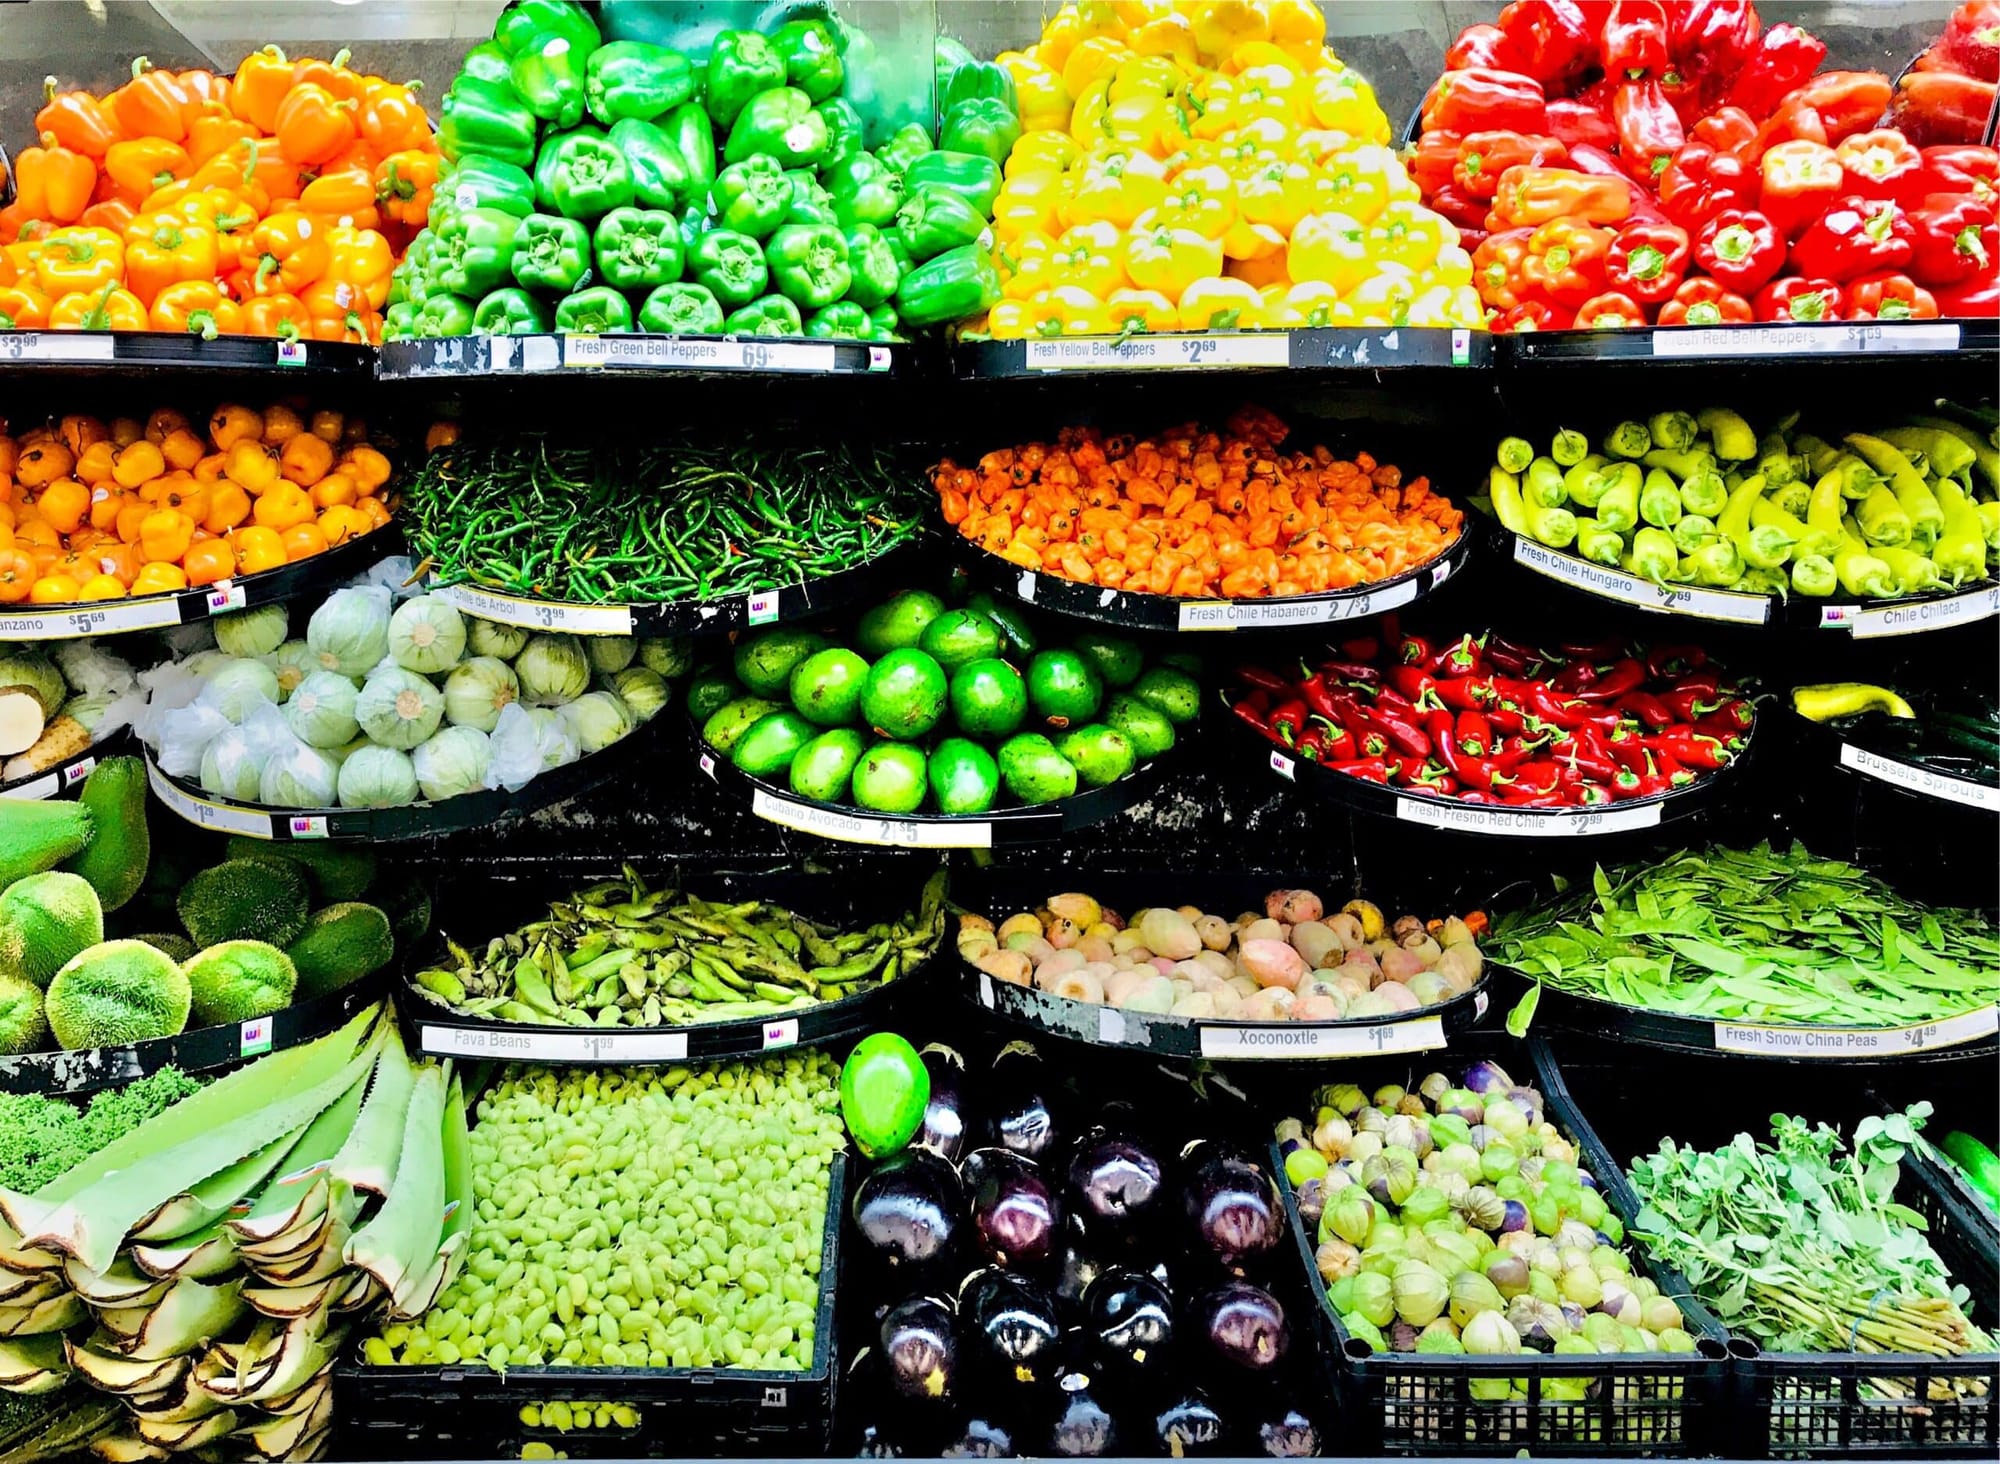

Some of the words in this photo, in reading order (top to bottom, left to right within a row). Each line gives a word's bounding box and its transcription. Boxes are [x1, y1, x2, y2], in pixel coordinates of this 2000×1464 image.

[1703, 330, 1728, 346] Red
[1732, 329, 1757, 346] Bell
[1761, 328, 1816, 347] Peppers
[575, 340, 606, 355] Fresh
[610, 340, 643, 356] Green
[647, 341, 668, 356] Bell
[671, 342, 717, 360] Peppers
[1033, 342, 1058, 357] Fresh
[1059, 342, 1090, 357] Yellow
[1521, 543, 1549, 565] Fresh
[1551, 555, 1578, 576] Chile
[1580, 565, 1632, 592] Hungaro
[453, 586, 473, 605] Chile
[475, 596, 487, 608] de
[489, 598, 516, 615] Arbol
[1189, 606, 1223, 621] Fresh
[1227, 605, 1257, 620] Chile
[1260, 604, 1318, 620] Habanero
[1884, 608, 1917, 625] Chile
[1920, 599, 1960, 620] Chilaca
[1856, 750, 1919, 782] Brussels
[1922, 771, 1985, 802] Sprouts
[764, 796, 804, 820] Cubano
[808, 812, 862, 832] Avocado
[1407, 800, 1440, 818] Fresh
[1444, 807, 1485, 826] Fresno
[1488, 812, 1512, 827] Red
[1515, 814, 1546, 829] Chile
[453, 1030, 486, 1048] Fava
[489, 1031, 531, 1049] Beans
[1238, 1029, 1319, 1045] Xoconoxtle
[1725, 1027, 1762, 1043] Fresh
[1766, 1031, 1802, 1046] Snow
[1805, 1033, 1843, 1047] China
[1847, 1033, 1878, 1047] Peas
